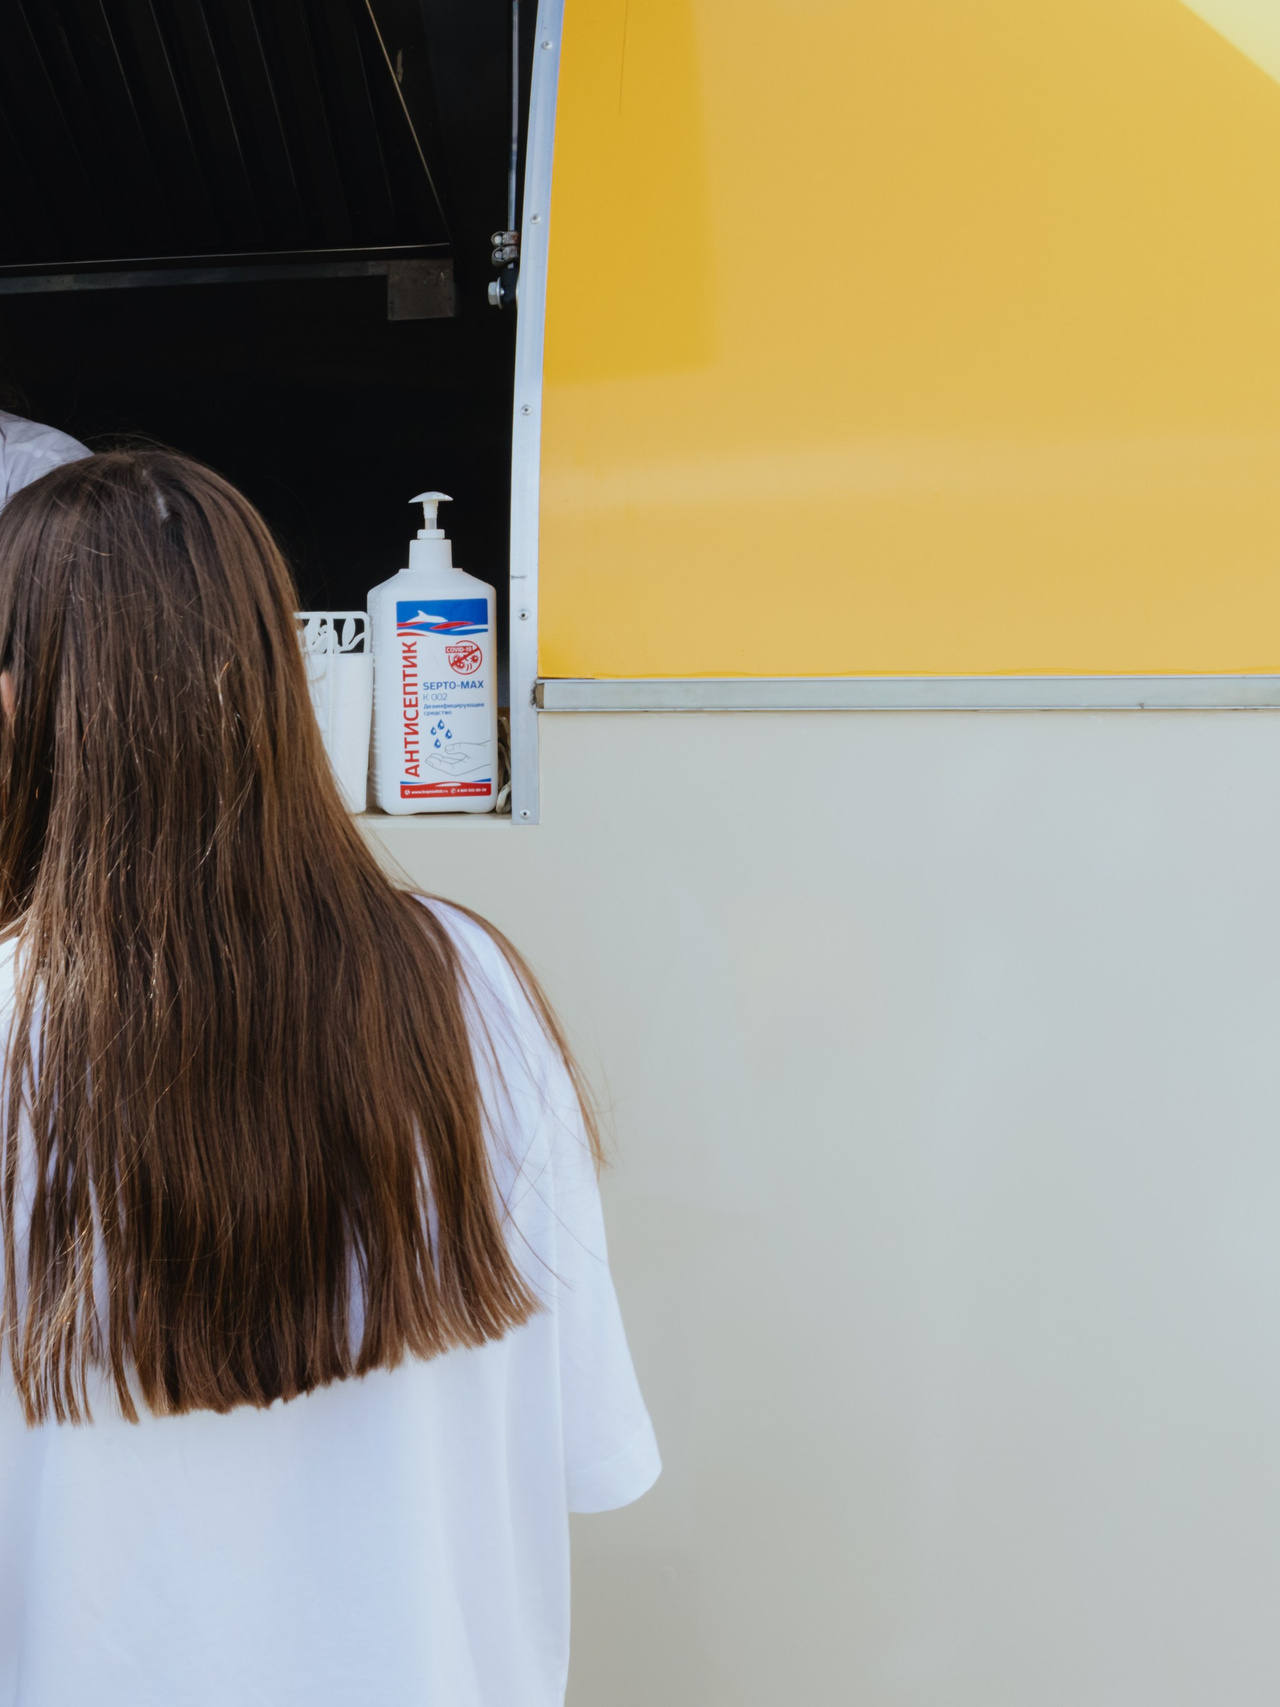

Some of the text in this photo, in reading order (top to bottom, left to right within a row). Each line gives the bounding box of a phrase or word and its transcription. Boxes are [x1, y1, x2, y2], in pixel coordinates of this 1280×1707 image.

[422, 680, 484, 690] SEPTO-MAX
[431, 693, 448, 701] 002
[402, 641, 420, 777] АНТИСЕПТИК
